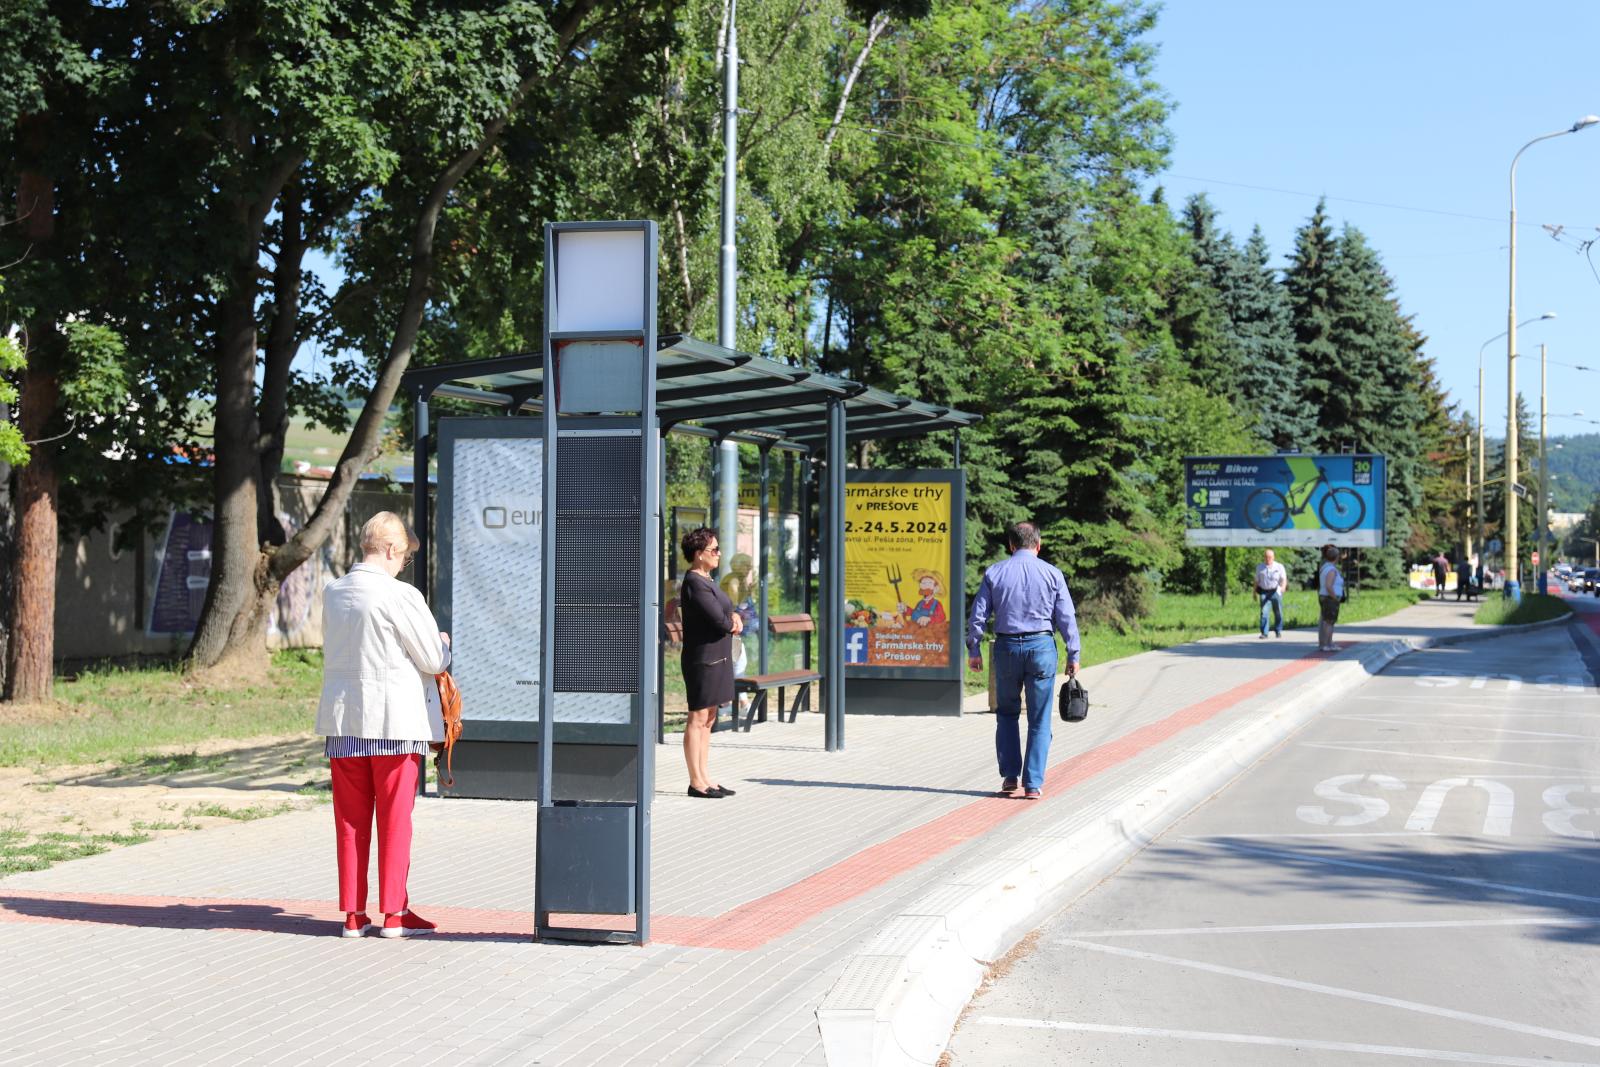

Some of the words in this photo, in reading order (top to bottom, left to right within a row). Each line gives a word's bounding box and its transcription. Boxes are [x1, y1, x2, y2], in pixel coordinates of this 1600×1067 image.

[1354, 461, 1370, 472] 30
[914, 486, 944, 501] trhy
[856, 503, 863, 511] v
[866, 500, 919, 511] PREŠOVE
[875, 641, 923, 650] Farmárske
[925, 641, 944, 652] trhy
[884, 652, 922, 661] Prešove
[1414, 671, 1585, 692] BUS
